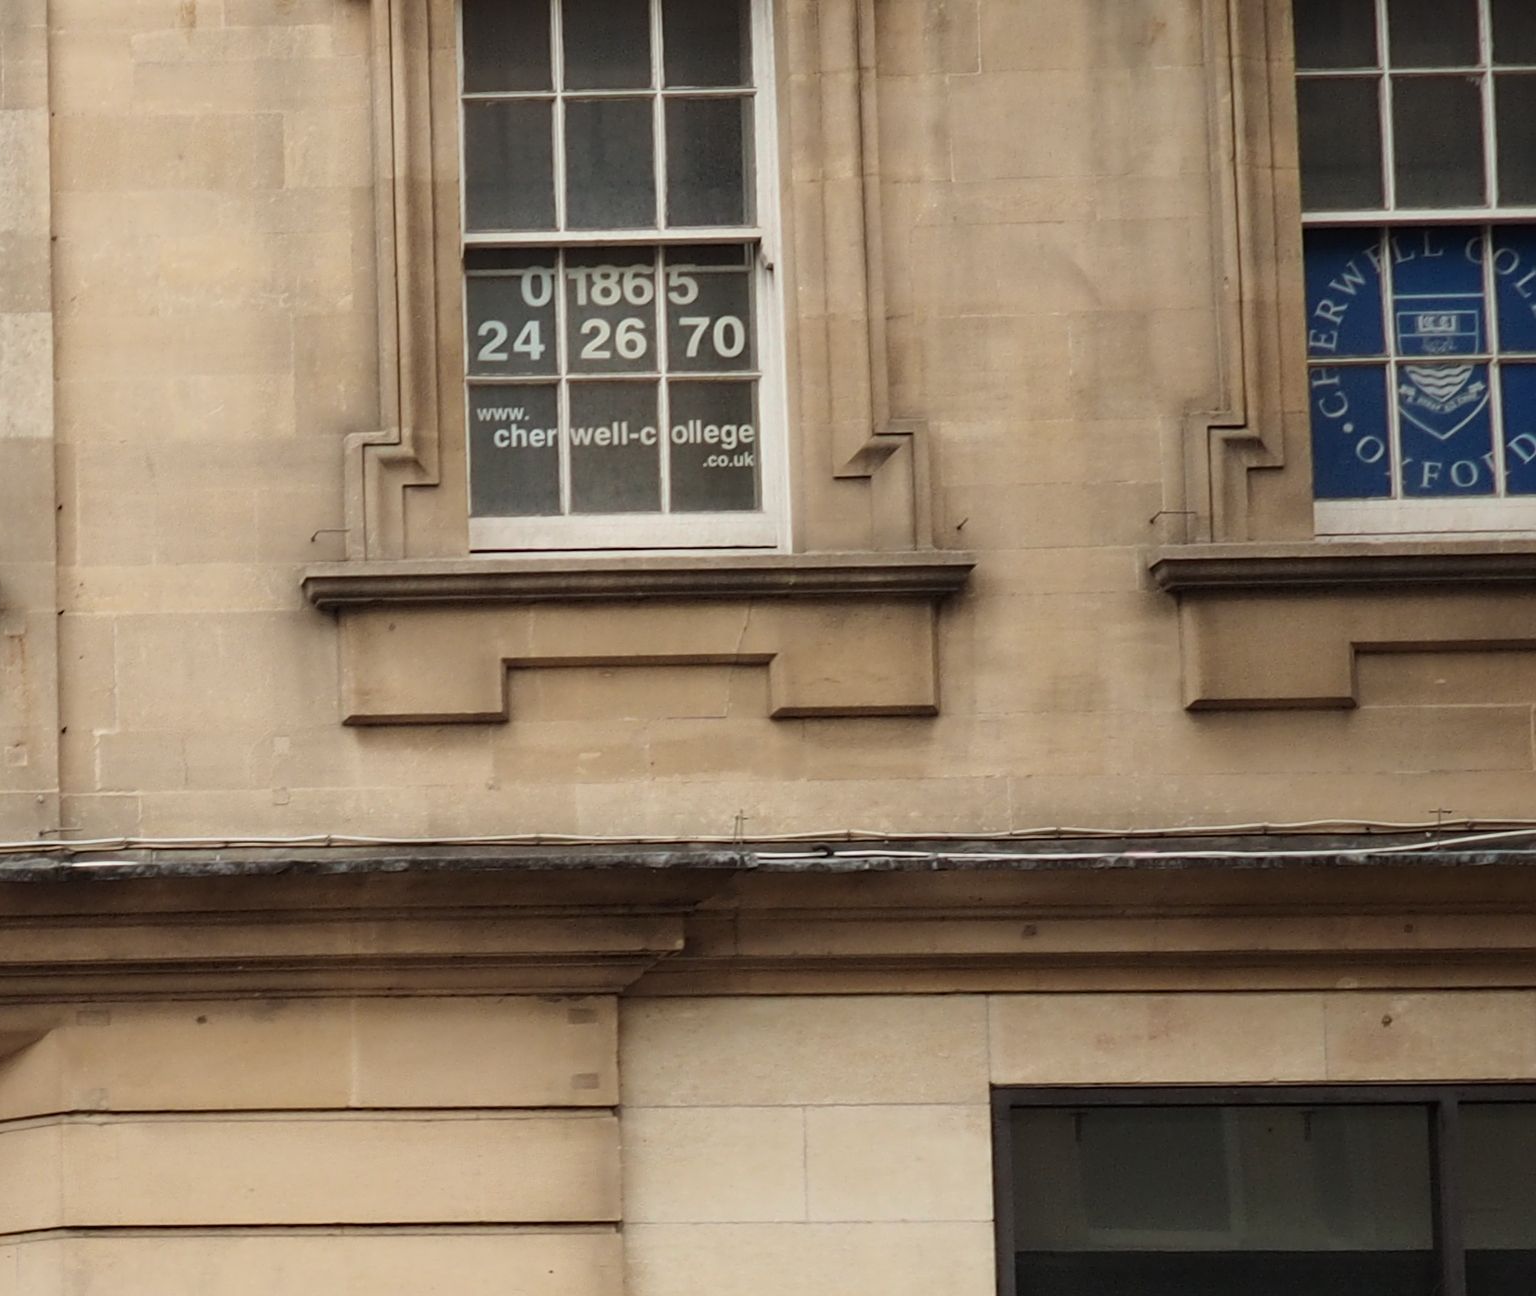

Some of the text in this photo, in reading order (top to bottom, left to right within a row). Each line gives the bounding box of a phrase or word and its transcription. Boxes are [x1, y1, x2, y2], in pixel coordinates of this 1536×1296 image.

[521, 263, 699, 307] 01865
[477, 315, 745, 361] 24 26 70
[476, 406, 530, 421] www.
[493, 419, 755, 450] cherwell-college
[702, 452, 754, 467] .co.uk
[1355, 433, 1536, 489] OFOD
